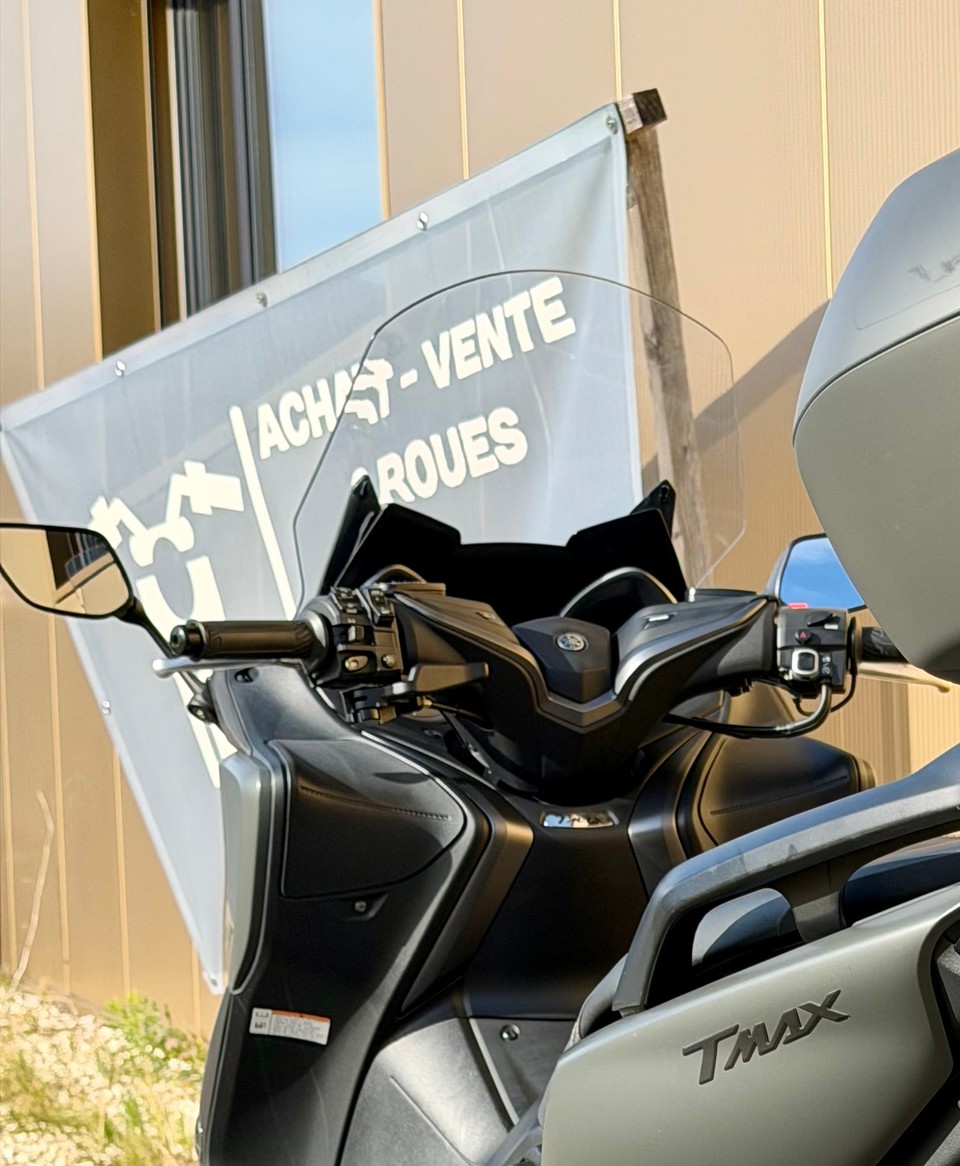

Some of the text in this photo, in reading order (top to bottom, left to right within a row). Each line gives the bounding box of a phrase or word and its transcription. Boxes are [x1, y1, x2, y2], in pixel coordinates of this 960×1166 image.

[400, 368, 418, 389] -
[421, 276, 577, 390] VENTE
[376, 406, 529, 505] ROUES
[682, 989, 851, 1085] TMAX
